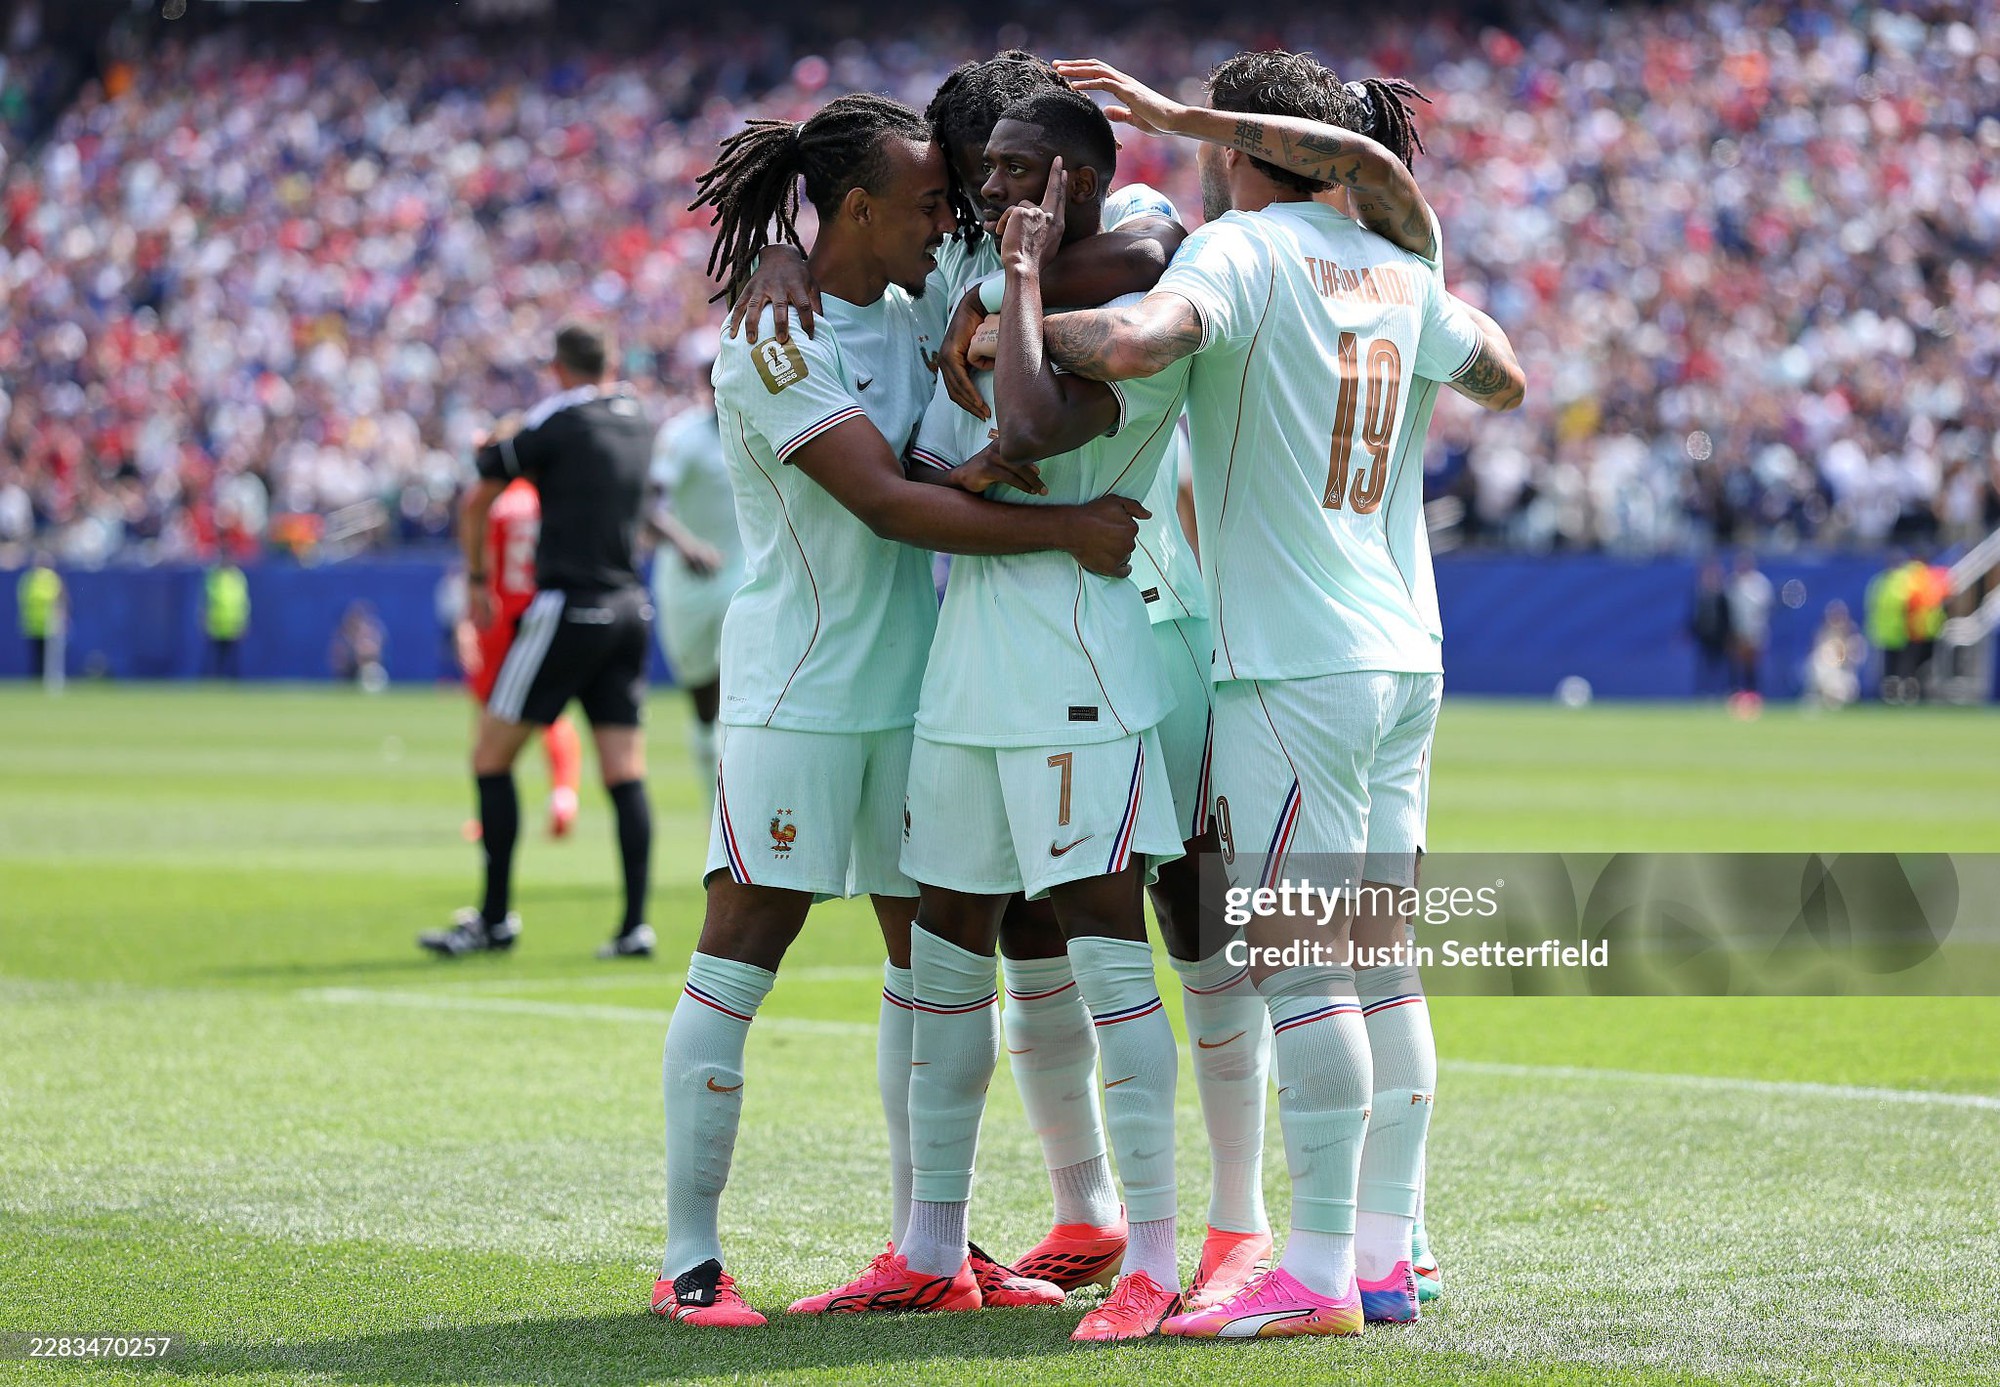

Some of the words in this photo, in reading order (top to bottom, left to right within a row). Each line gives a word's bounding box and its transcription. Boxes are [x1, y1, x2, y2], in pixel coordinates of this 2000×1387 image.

[777, 373, 798, 387] 2026
[1322, 331, 1401, 514] 19
[1047, 752, 1073, 826] 7
